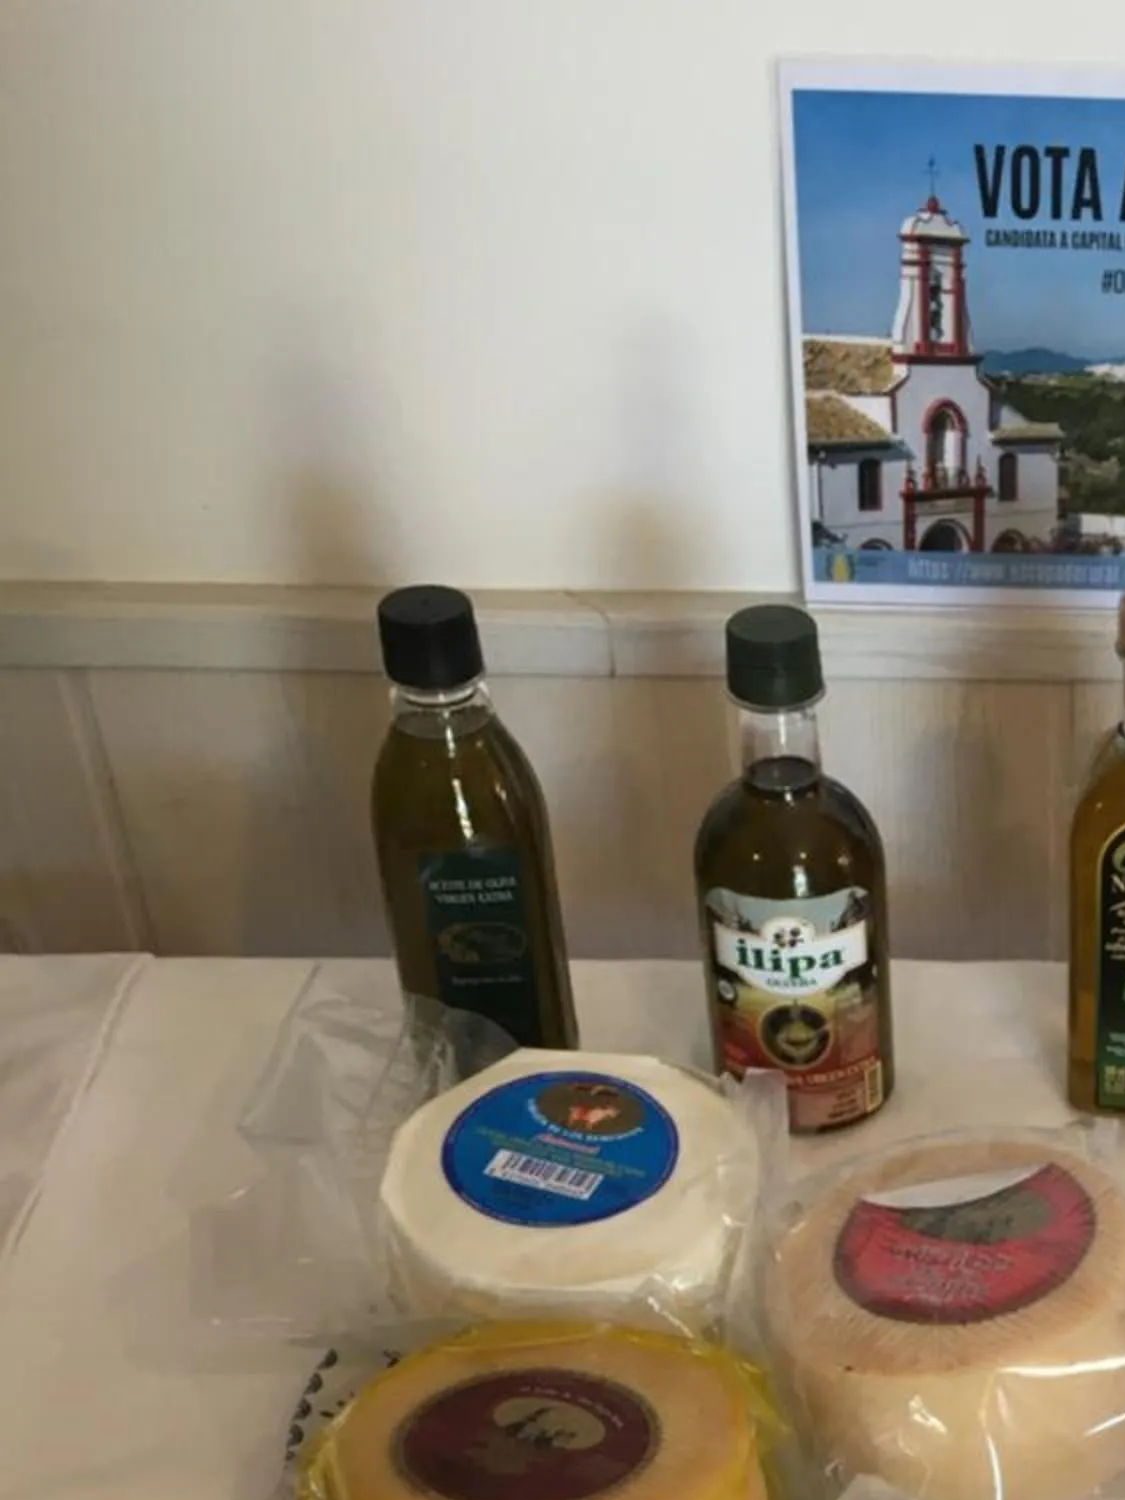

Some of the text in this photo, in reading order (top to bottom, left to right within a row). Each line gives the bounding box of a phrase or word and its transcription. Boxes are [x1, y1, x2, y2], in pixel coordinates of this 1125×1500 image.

[973, 143, 1103, 221] VOTA
[985, 229, 1057, 248] CANDIDATA
[1060, 233, 1069, 248] A
[1071, 231, 1122, 250] CAPITAL
[736, 939, 846, 977] ilipa
